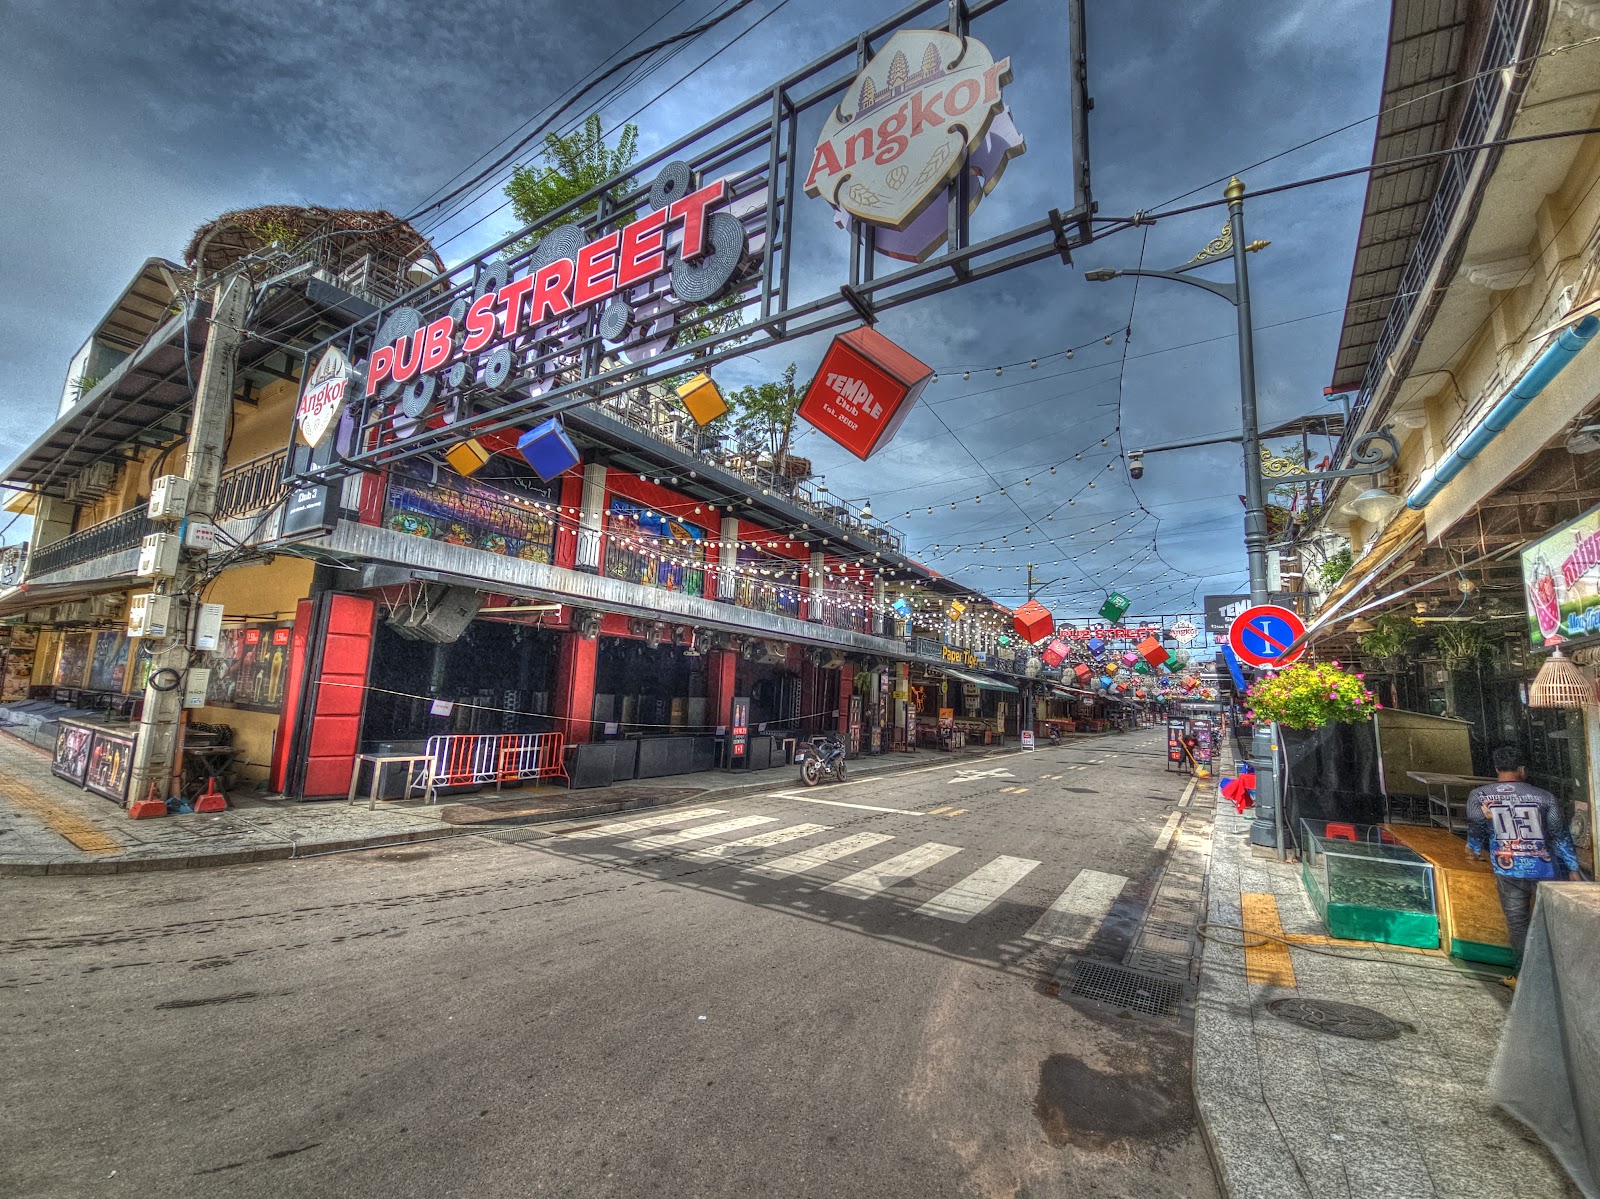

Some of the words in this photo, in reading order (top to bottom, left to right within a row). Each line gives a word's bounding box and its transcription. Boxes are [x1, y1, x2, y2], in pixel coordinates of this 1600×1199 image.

[804, 56, 1011, 188] Angkor
[366, 315, 455, 397] PUB
[462, 179, 726, 353] STREET
[297, 377, 348, 419] Angkor
[825, 372, 883, 420] TEMPLE
[835, 395, 859, 417] Club
[942, 646, 962, 664] Paper
[963, 650, 979, 668] Tiger
[1489, 804, 1545, 841] 03
